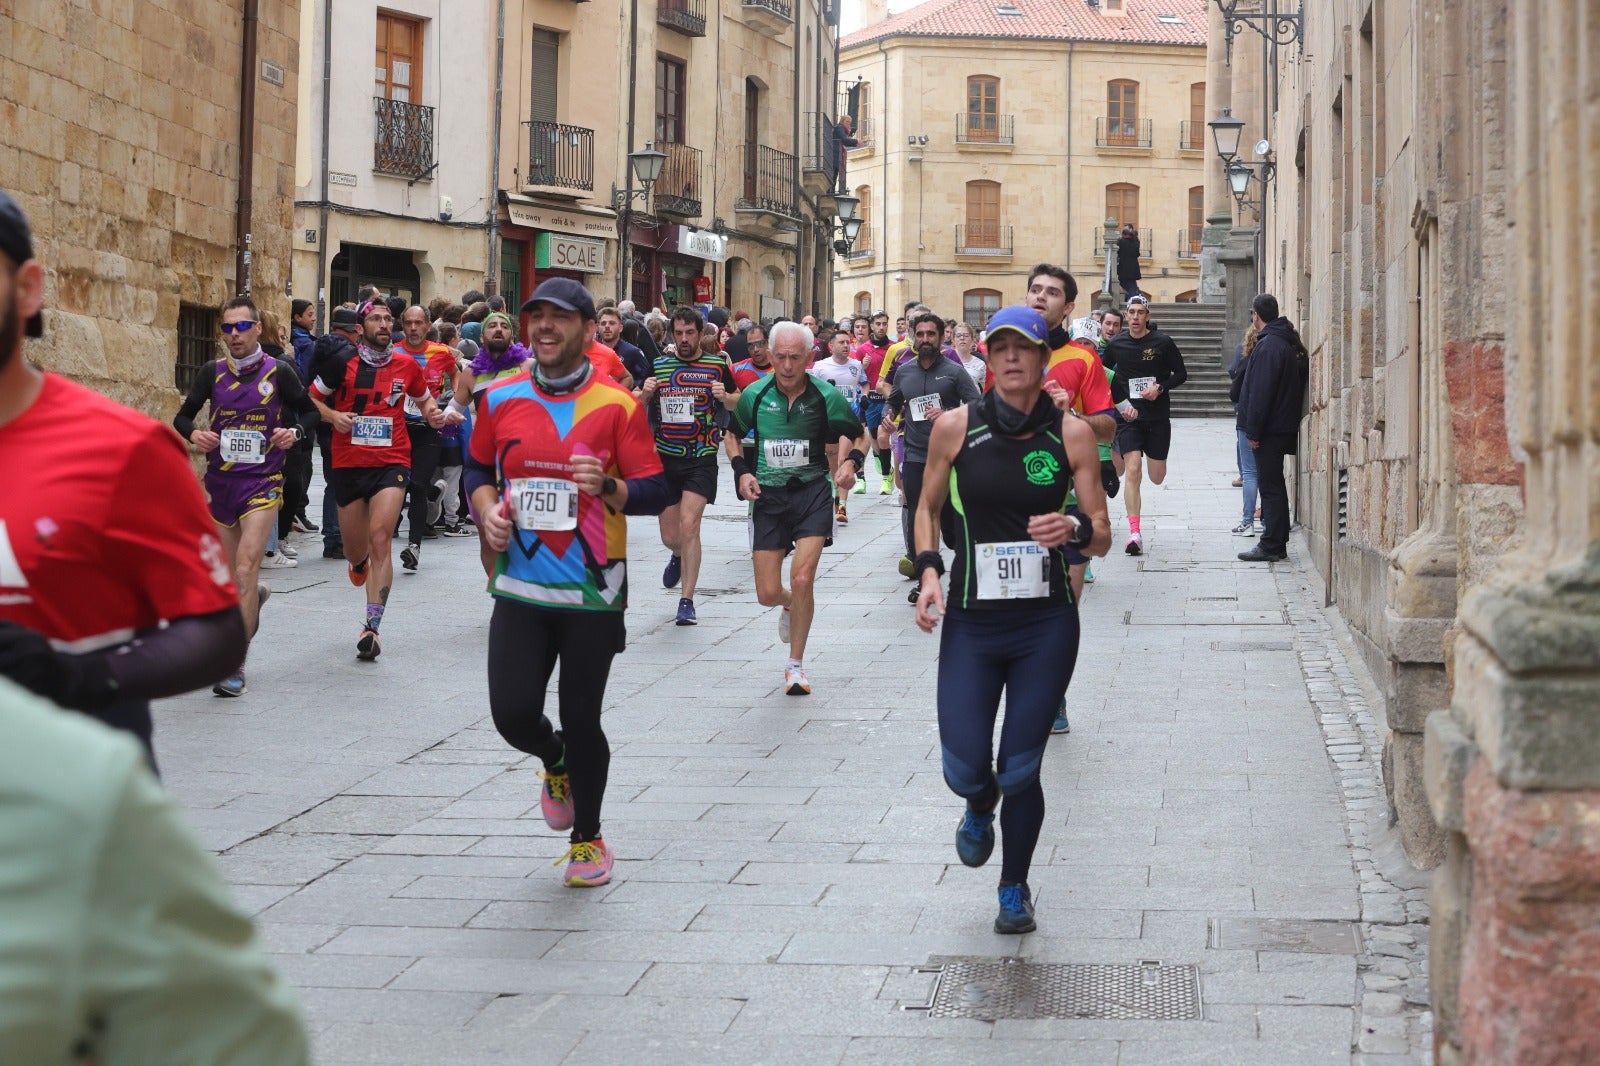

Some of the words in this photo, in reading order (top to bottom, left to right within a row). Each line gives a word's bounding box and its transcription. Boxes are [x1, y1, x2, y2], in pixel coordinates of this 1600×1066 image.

[525, 214, 542, 223] away
[557, 243, 597, 268] SCALE
[671, 386, 707, 394] SILVESTRE
[665, 403, 684, 414] 1622
[357, 423, 384, 437] 3426
[230, 438, 252, 452] 666
[772, 444, 796, 457] 1037
[527, 480, 571, 491] SETEL
[520, 491, 557, 512] 1750
[995, 545, 1043, 556] SETEL
[998, 557, 1021, 579] 911
